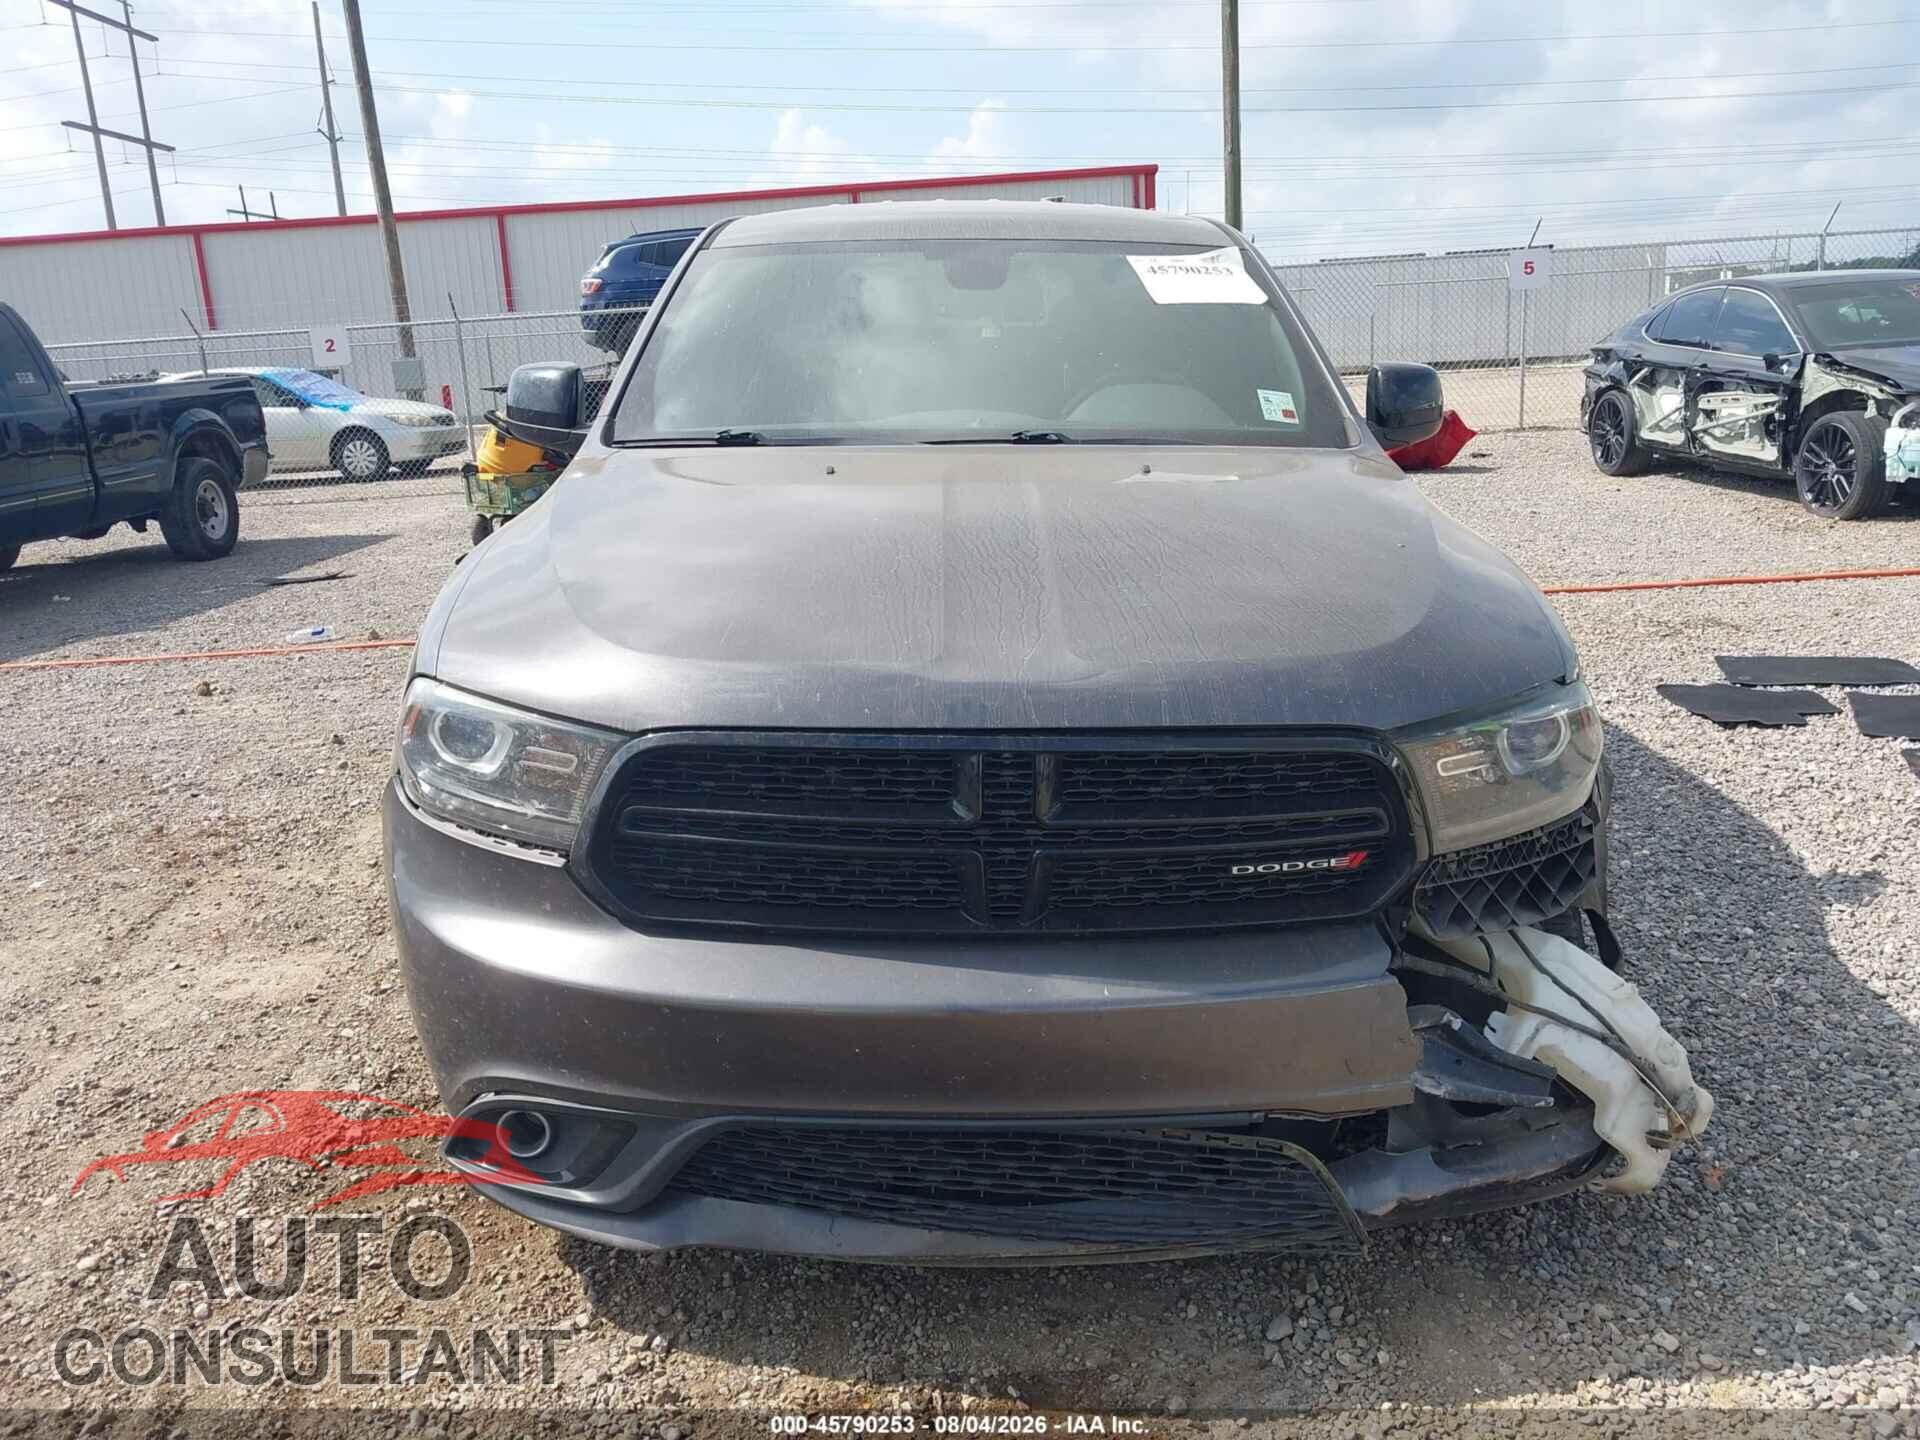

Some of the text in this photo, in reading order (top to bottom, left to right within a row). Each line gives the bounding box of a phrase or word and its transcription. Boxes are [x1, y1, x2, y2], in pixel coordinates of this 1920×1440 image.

[1524, 261, 1535, 276] 5
[325, 338, 336, 353] 2
[1232, 857, 1351, 875] DODGE
